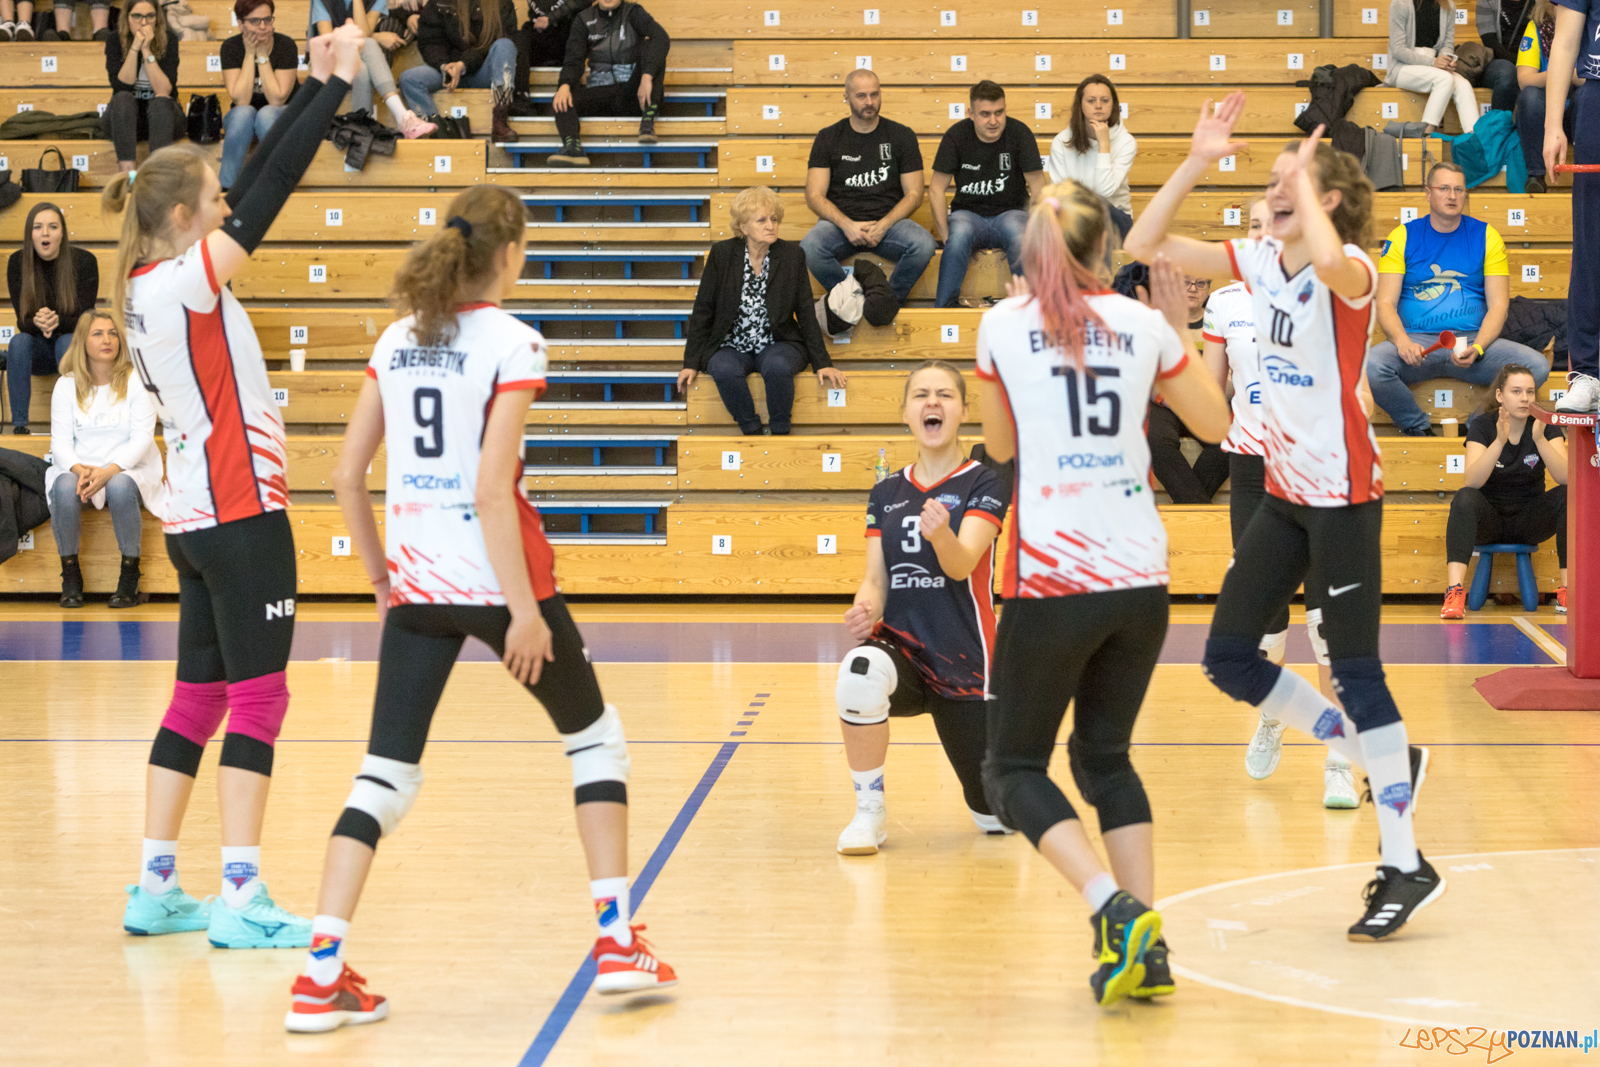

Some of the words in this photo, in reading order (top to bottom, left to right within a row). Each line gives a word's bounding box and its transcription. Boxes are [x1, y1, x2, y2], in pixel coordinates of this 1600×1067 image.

[1199, 12, 1204, 20] 3
[1041, 57, 1046, 65] 5
[456, 109, 462, 117] 9
[76, 158, 85, 166] 13
[762, 158, 767, 166] 8
[1225, 157, 1230, 165] 3
[330, 212, 339, 220] 10
[1230, 211, 1235, 219] 3
[1512, 212, 1521, 220] 16
[314, 268, 323, 276] 10
[1526, 268, 1536, 276] 16
[1270, 304, 1293, 348] 10
[2, 329, 11, 337] 13
[295, 329, 304, 338] 10
[947, 328, 953, 336] 6
[390, 348, 468, 375] ENERGETYK
[1266, 366, 1314, 387] Enea
[275, 392, 284, 400] 10
[834, 392, 840, 400] 7
[1051, 366, 1121, 437] 15
[413, 386, 444, 458] 9
[1558, 416, 1594, 425] Senoh
[728, 454, 734, 463] 8
[829, 457, 834, 465] 7
[901, 516, 922, 553] 3
[338, 540, 344, 549] 9
[719, 538, 725, 548] 8
[824, 538, 830, 547] 7
[891, 573, 945, 589] Enea
[265, 598, 296, 620] NB
